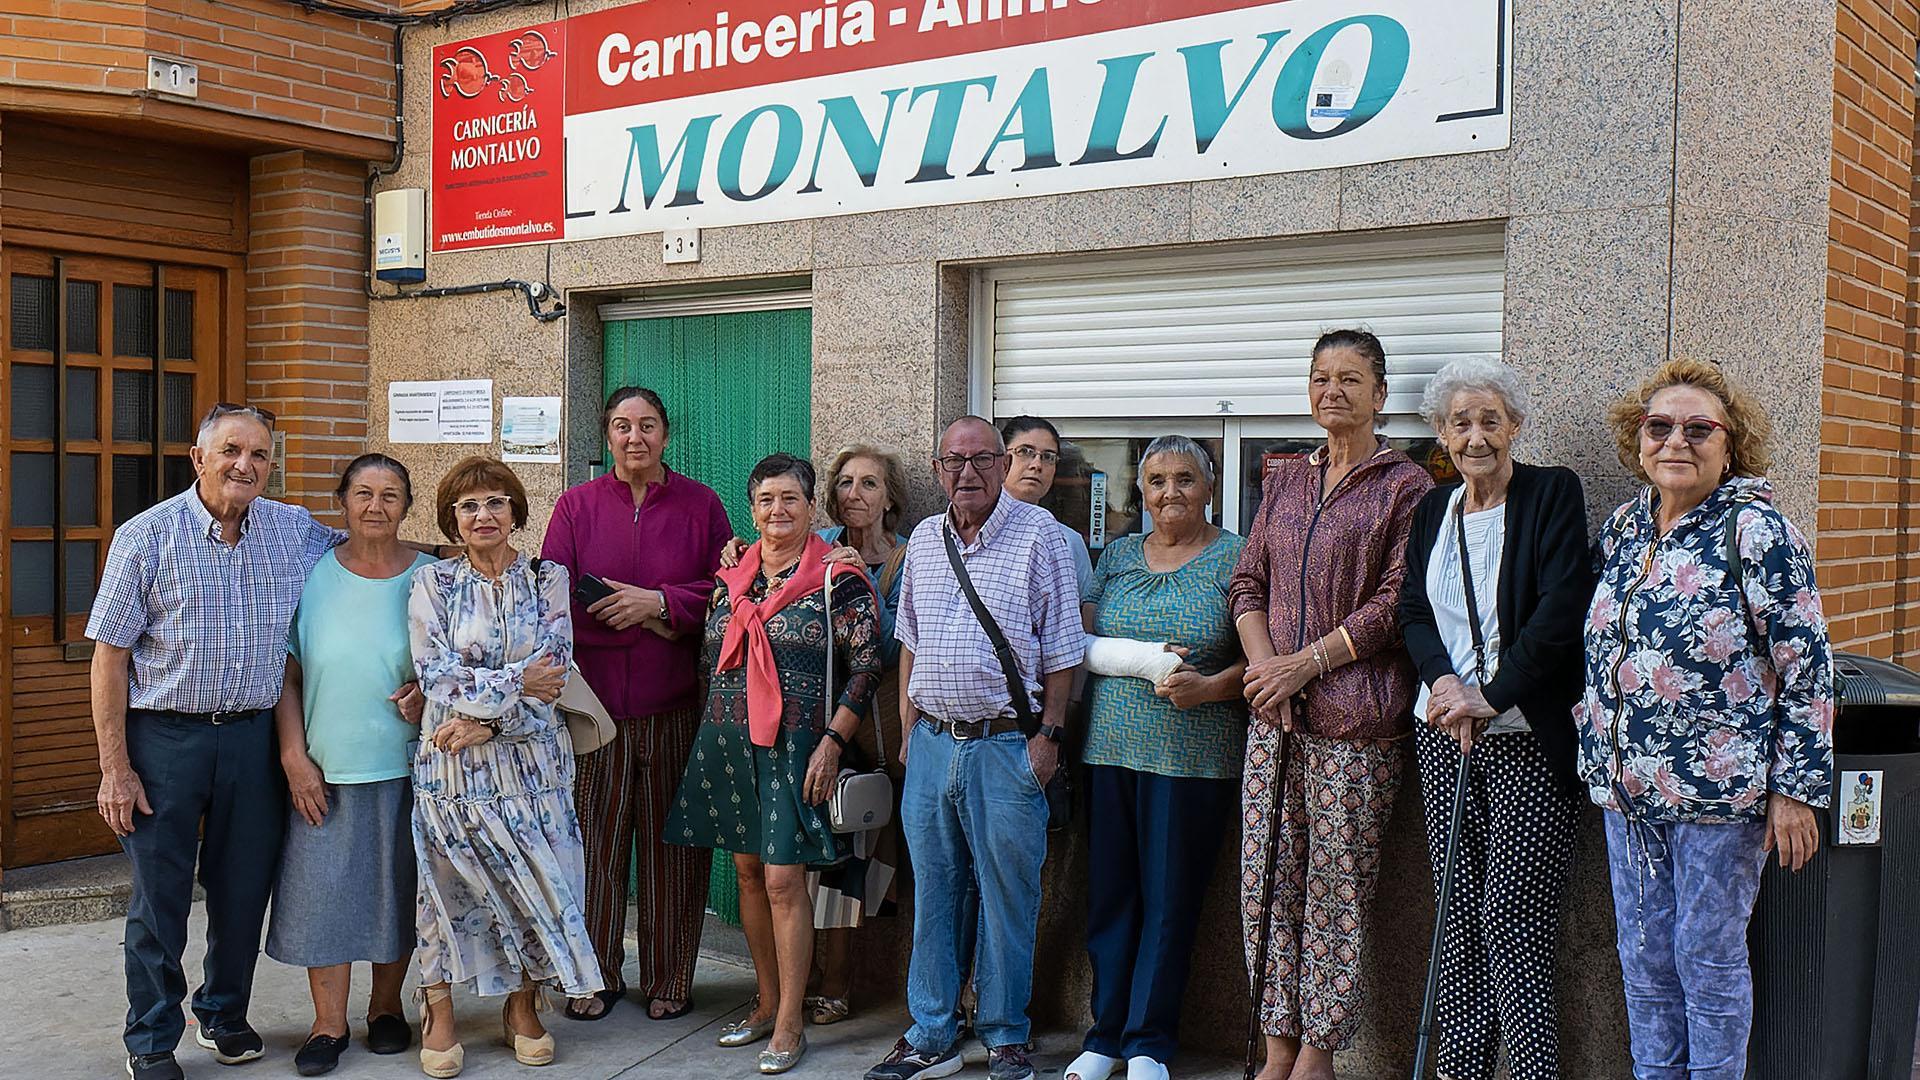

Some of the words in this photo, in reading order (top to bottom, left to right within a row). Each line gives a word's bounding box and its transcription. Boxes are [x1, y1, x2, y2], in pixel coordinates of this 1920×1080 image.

[597, 0, 876, 86] Carniceria
[172, 69, 177, 85] 1
[453, 104, 538, 142] CARNICERÍA
[608, 14, 1410, 213] MONTALVO
[451, 136, 541, 171] MONTALVO
[475, 210, 493, 220] Tienda
[676, 237, 683, 254] 3
